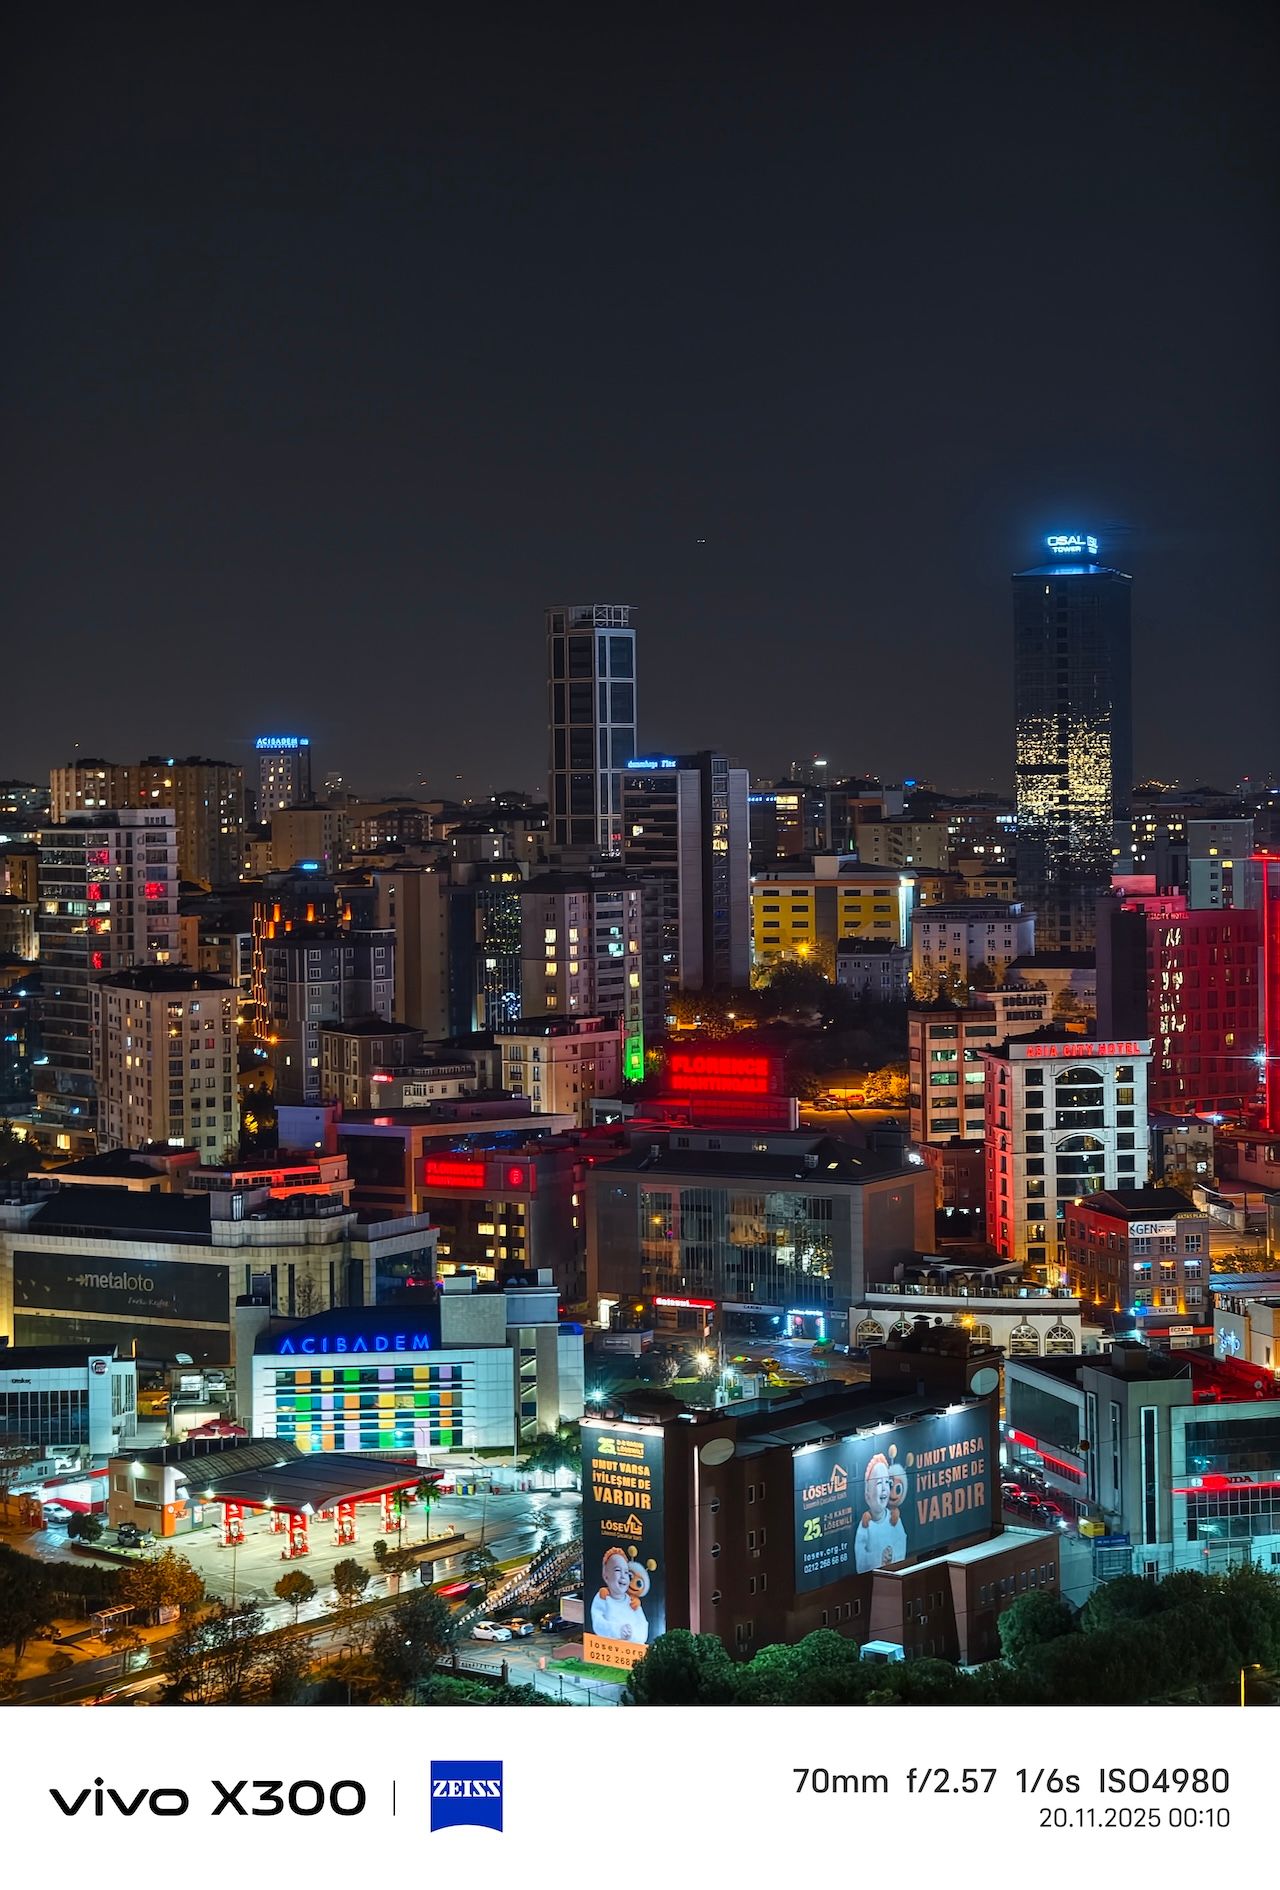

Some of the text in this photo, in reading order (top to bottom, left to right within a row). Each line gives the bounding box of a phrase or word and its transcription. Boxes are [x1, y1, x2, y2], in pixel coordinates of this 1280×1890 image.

[1063, 1043, 1094, 1056] CITY
[1098, 1042, 1140, 1056] HOTEL
[671, 1056, 768, 1076] FLORENCE
[1136, 1223, 1158, 1234] GEN
[84, 1272, 154, 1291] metaloto
[280, 1334, 430, 1354] ACIBADEM
[916, 1447, 947, 1469] UMUT
[949, 1437, 984, 1460] VARSA
[592, 1459, 651, 1476] UMUT VARSA
[916, 1458, 985, 1493] İYİLEŞME DE
[592, 1470, 651, 1490] İYİLEŞME DE
[592, 1486, 652, 1510] VARDIR
[803, 1482, 834, 1502] LÖSEV
[917, 1482, 985, 1525] VARDIR
[601, 1520, 629, 1533] LÖSEV
[804, 1543, 848, 1562] losev.org.tr
[804, 1562, 819, 1574] 0212
[590, 1652, 631, 1666] 0212 268
